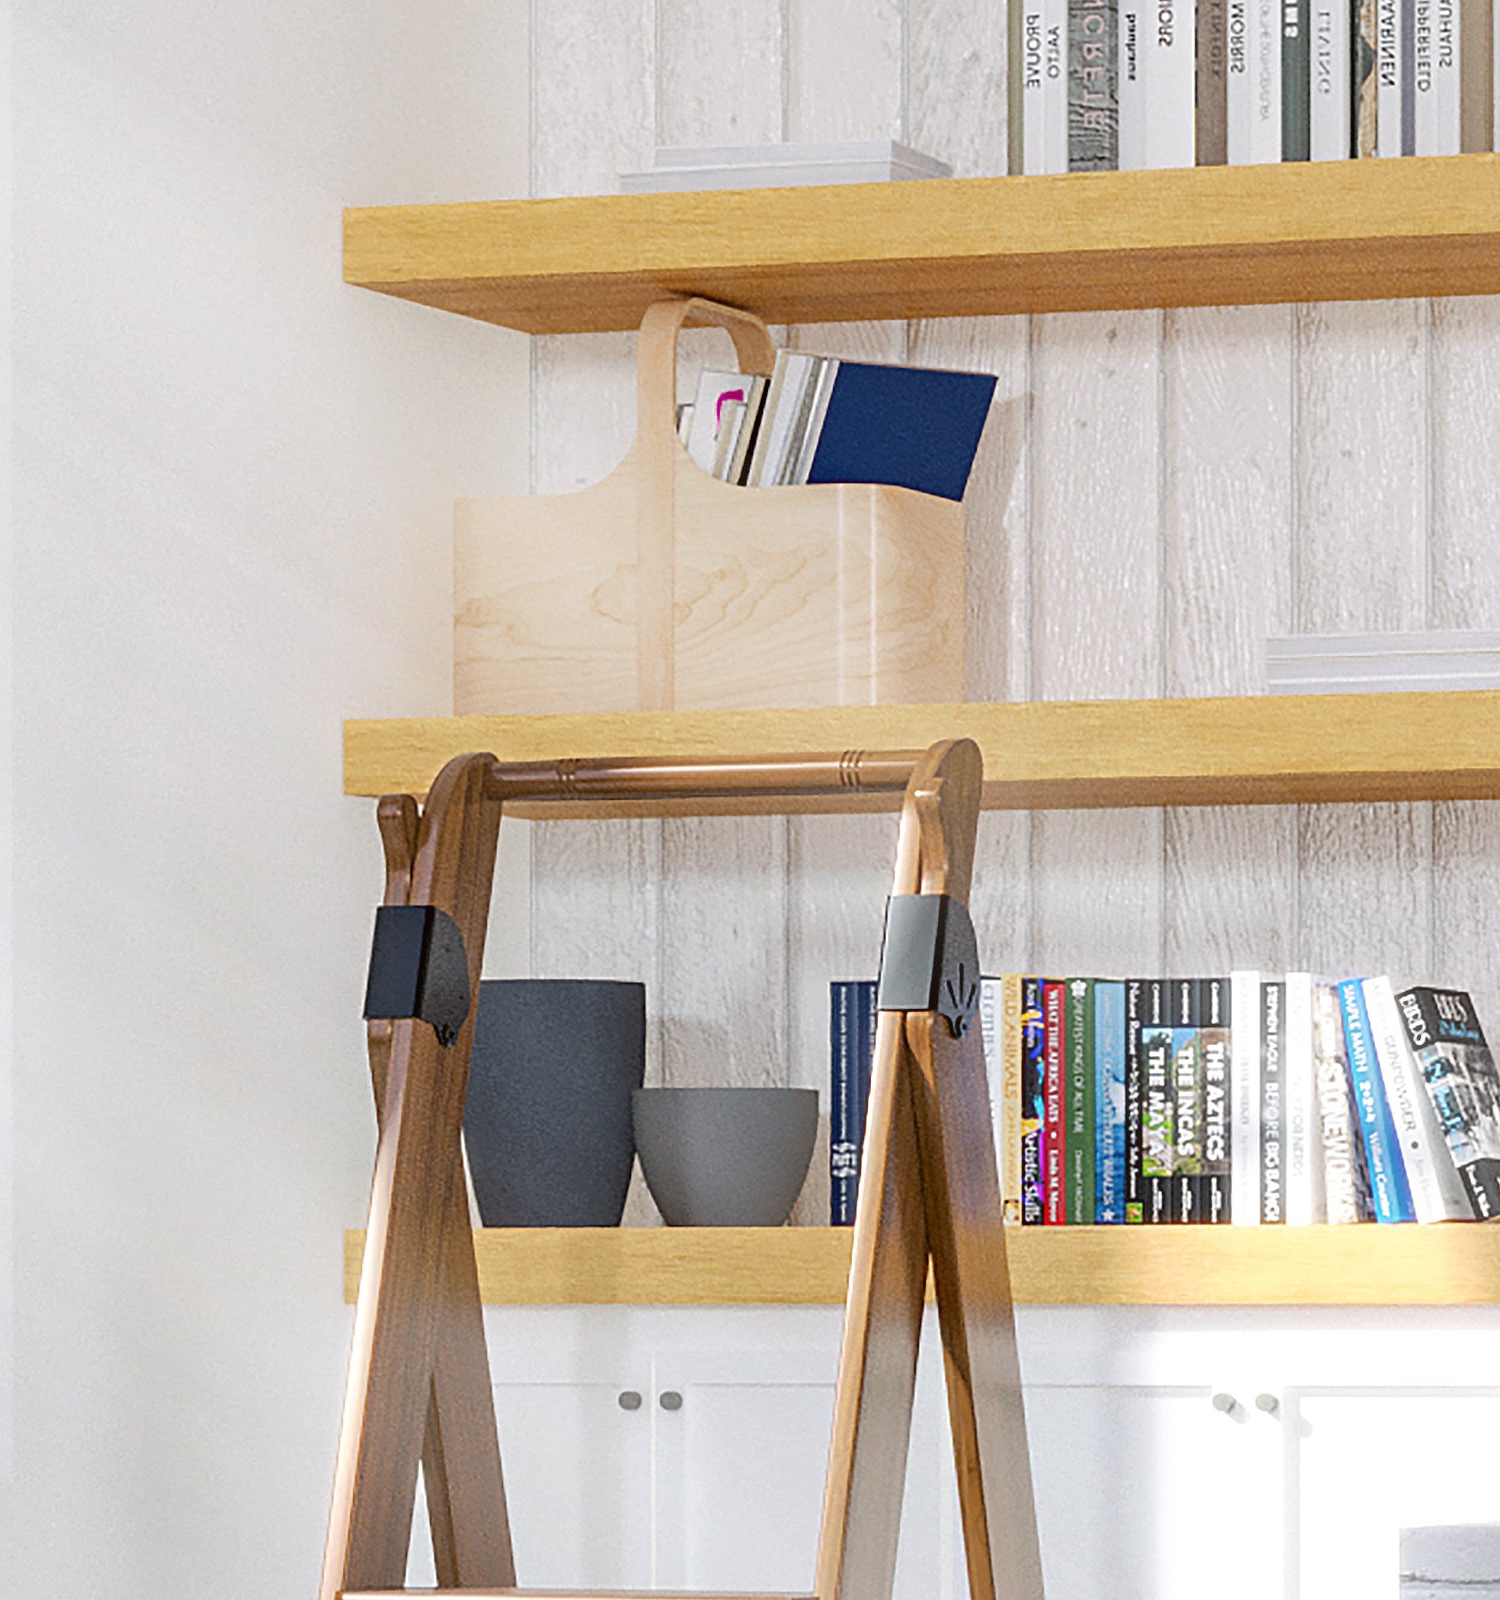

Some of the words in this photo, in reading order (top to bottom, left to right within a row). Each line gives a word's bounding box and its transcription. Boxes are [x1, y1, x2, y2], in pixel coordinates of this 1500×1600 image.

[1005, 978, 1017, 1016] WILD
[1048, 990, 1058, 1023] WHAT
[1266, 986, 1278, 1033] STEPHEN
[1343, 984, 1362, 1033] SIMPLE
[1048, 1027, 1058, 1046] THE
[1399, 993, 1430, 1046] BIRDS
[1005, 1022, 1018, 1099] ANIMALS
[1048, 1047, 1058, 1092] AFRICA
[1148, 1048, 1164, 1087] THE
[1178, 1048, 1194, 1087] THE
[1207, 1042, 1223, 1083] THE
[1266, 1035, 1278, 1072] EAGLE
[1351, 1034, 1368, 1072] MATH
[1384, 1035, 1417, 1132] GUNPOWDER
[1148, 1092, 1164, 1155] MAYA
[1178, 1091, 1194, 1156] INCAS
[1207, 1087, 1224, 1161] AZTECS
[1266, 1082, 1280, 1138] BEFORE
[1266, 1141, 1280, 1167] BIG
[1024, 1184, 1039, 1223] Skills
